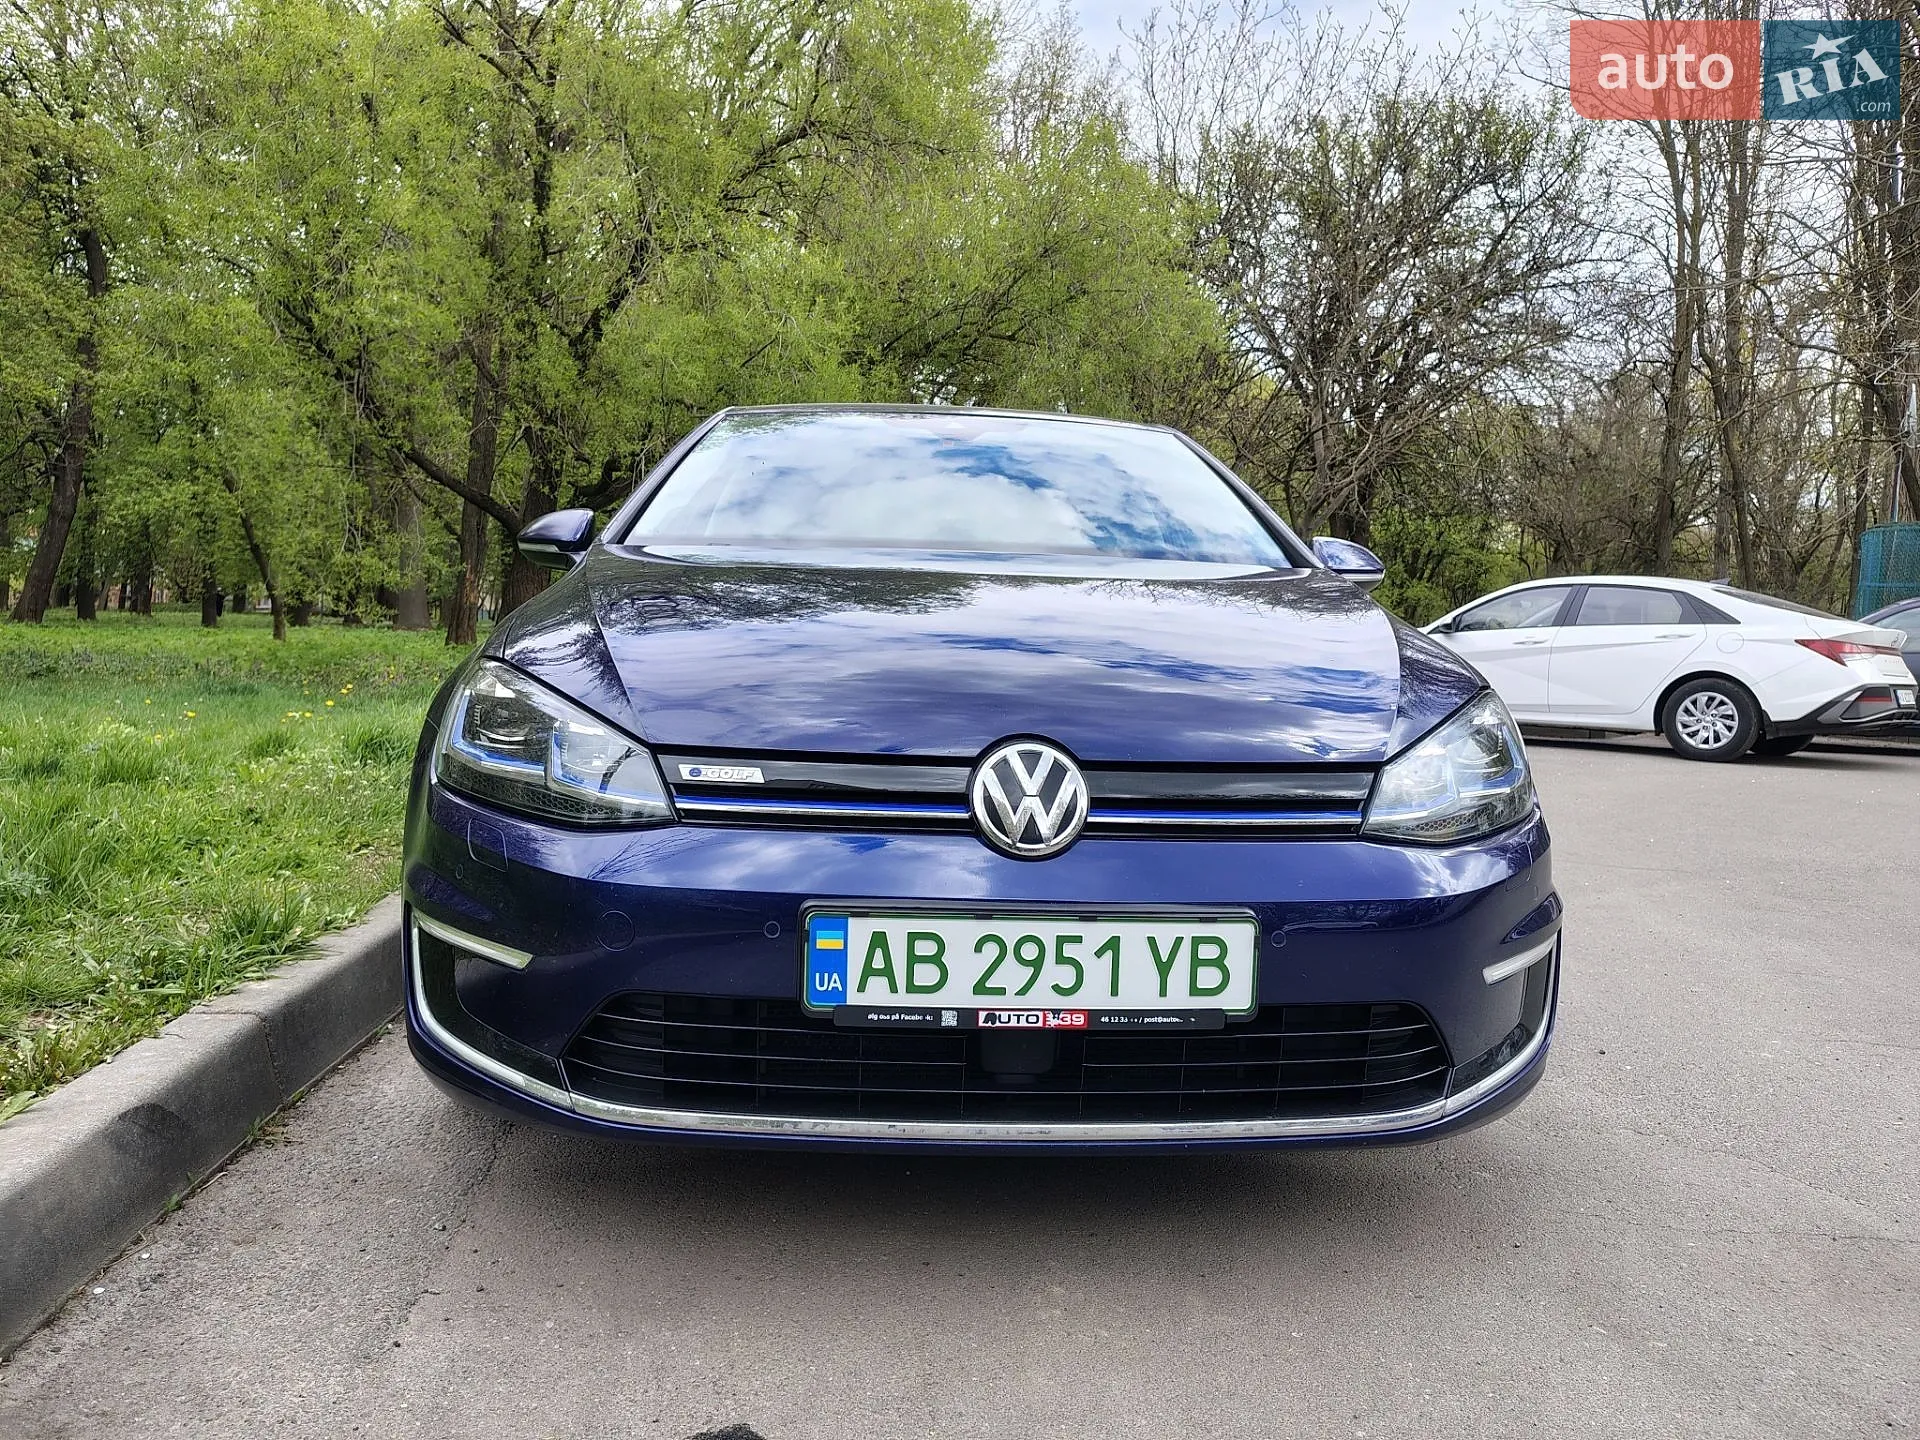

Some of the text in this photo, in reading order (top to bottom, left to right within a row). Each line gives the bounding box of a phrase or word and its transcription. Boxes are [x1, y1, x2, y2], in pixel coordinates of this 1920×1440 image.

[857, 930, 1231, 997] AB 2951 YB
[815, 973, 842, 992] UA
[982, 1012, 1041, 1026] AUTO
